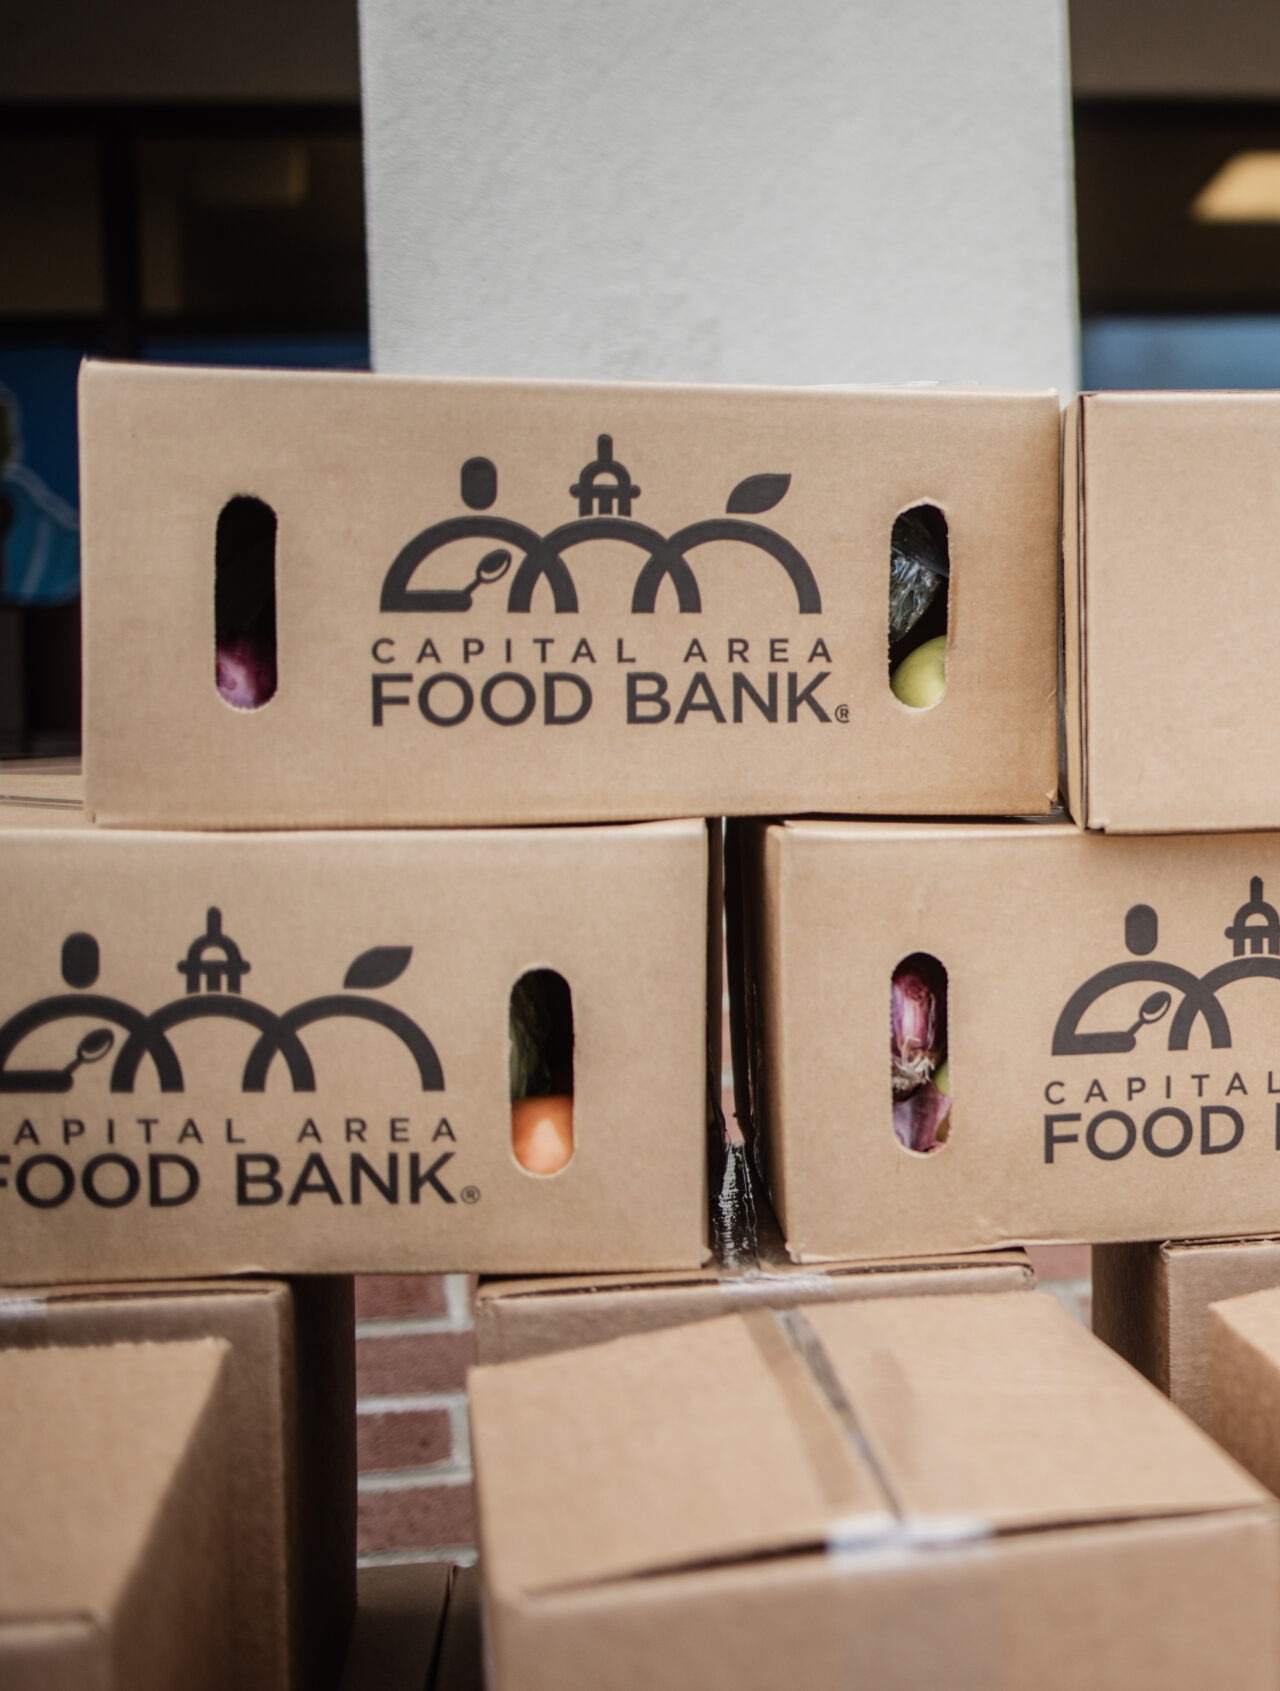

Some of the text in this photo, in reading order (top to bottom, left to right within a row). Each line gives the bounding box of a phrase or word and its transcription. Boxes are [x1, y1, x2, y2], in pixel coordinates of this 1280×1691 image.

[371, 637, 832, 664] CAPITAL AREA
[371, 671, 593, 728] FOOD
[12, 1117, 457, 1147] APITAL AREA
[1043, 1105, 1245, 1164] FOOD
